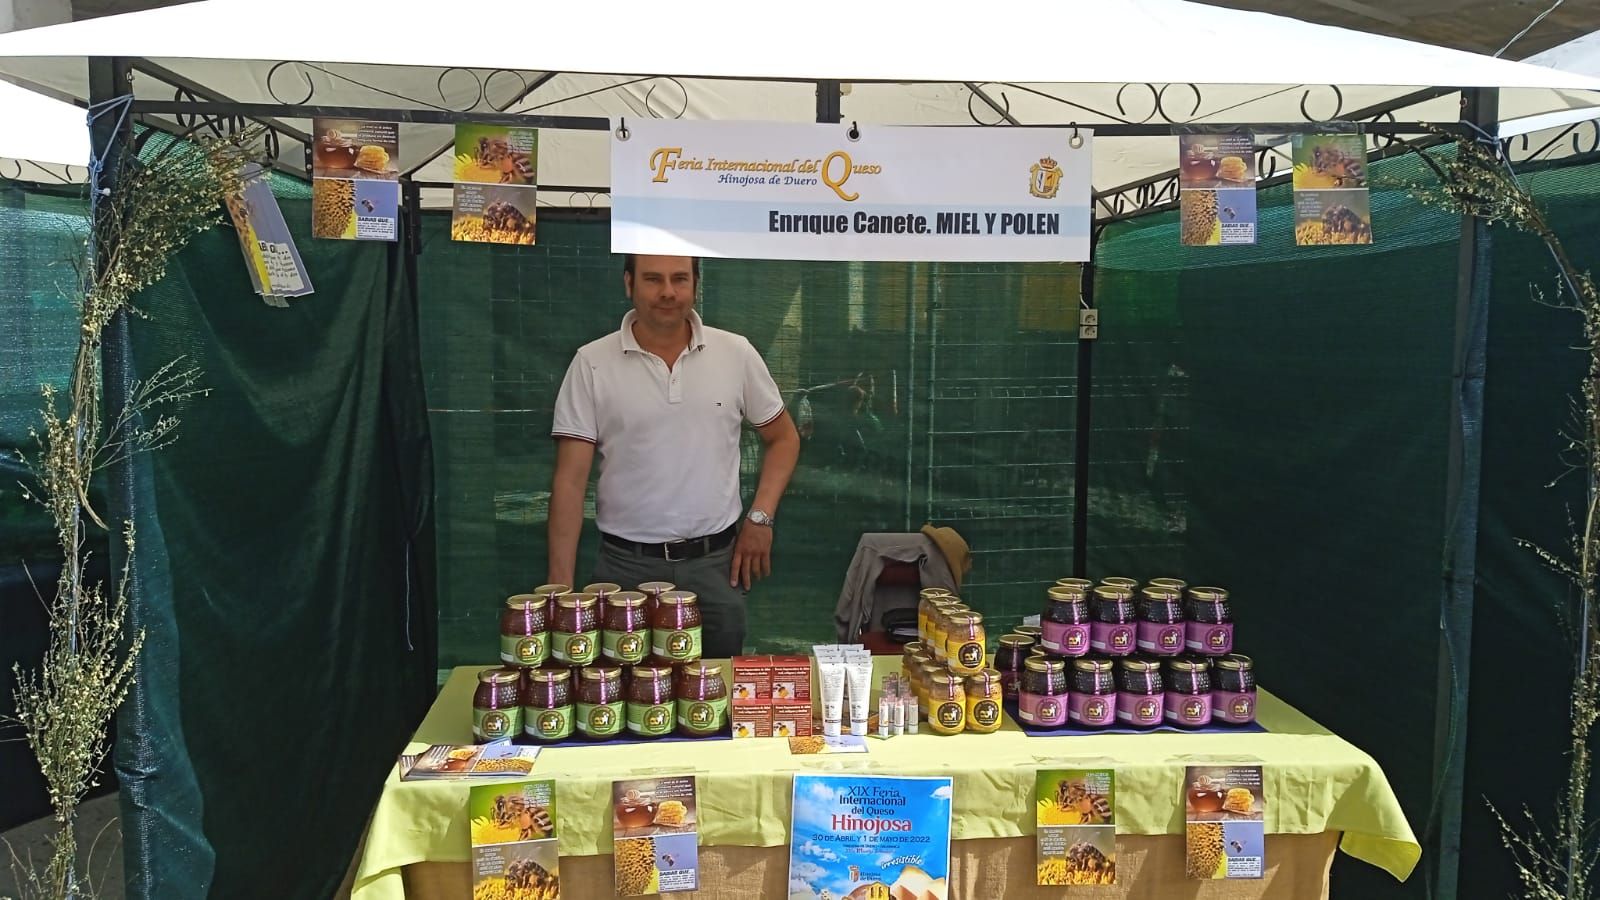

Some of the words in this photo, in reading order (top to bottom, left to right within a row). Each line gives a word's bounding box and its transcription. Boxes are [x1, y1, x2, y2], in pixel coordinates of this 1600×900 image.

[650, 147, 703, 183] Feria
[704, 158, 800, 174] Internacional
[798, 160, 822, 174] del
[822, 150, 882, 202] Queso
[718, 173, 765, 187] Hinojosa
[769, 175, 781, 185] de
[785, 175, 818, 186] Duero
[853, 211, 932, 235] Canete.
[936, 212, 980, 235] MIEL
[984, 213, 997, 235] Y
[1001, 213, 1060, 235] POLEN
[848, 786, 871, 797] XIX
[873, 787, 901, 798] Feria
[840, 795, 906, 806] Internacional
[852, 806, 865, 815] del
[866, 807, 895, 817] Queso
[831, 814, 912, 835] Hinojosa
[812, 834, 824, 842] 30
[881, 854, 923, 869] irresistible
